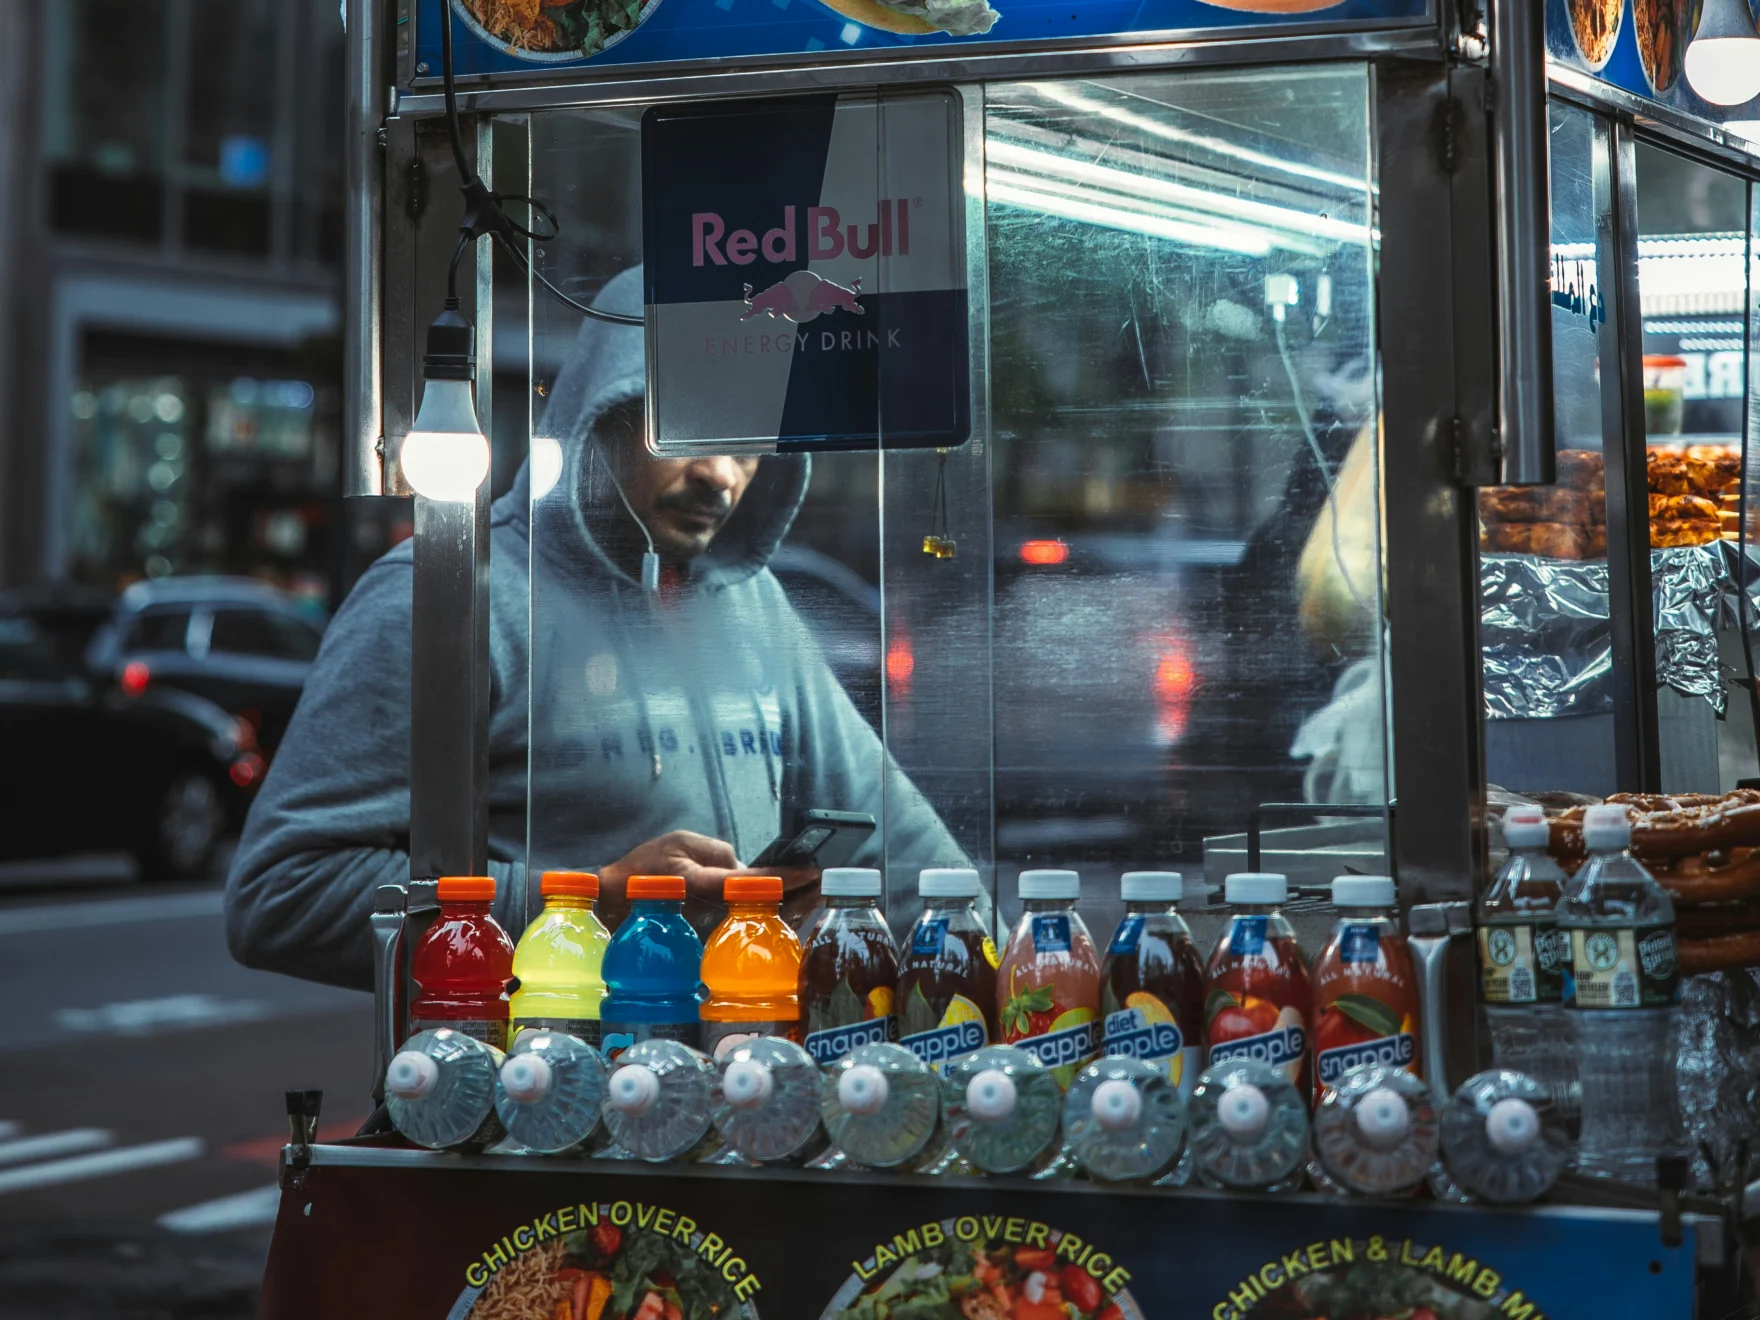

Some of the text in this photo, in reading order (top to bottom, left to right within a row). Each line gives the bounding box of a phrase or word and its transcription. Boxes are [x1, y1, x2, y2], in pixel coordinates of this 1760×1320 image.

[692, 198, 910, 267] Red Bull
[705, 328, 901, 356] ENERGY DRINK
[812, 935, 832, 949] ALL
[912, 959, 969, 979] NATURAL
[1015, 961, 1036, 978] ALL
[1211, 965, 1228, 980] ALL
[1320, 972, 1339, 986] ALL
[1107, 1010, 1138, 1036] diet
[903, 1022, 981, 1064] apple
[1025, 1021, 1101, 1066] napple
[1103, 1022, 1176, 1058] apple
[465, 1199, 762, 1303] CHICKEN OVER RICE
[851, 1215, 1131, 1294] LAMB OVER RICE
[1212, 1234, 1544, 1320] CHICKEN & LAMB M
